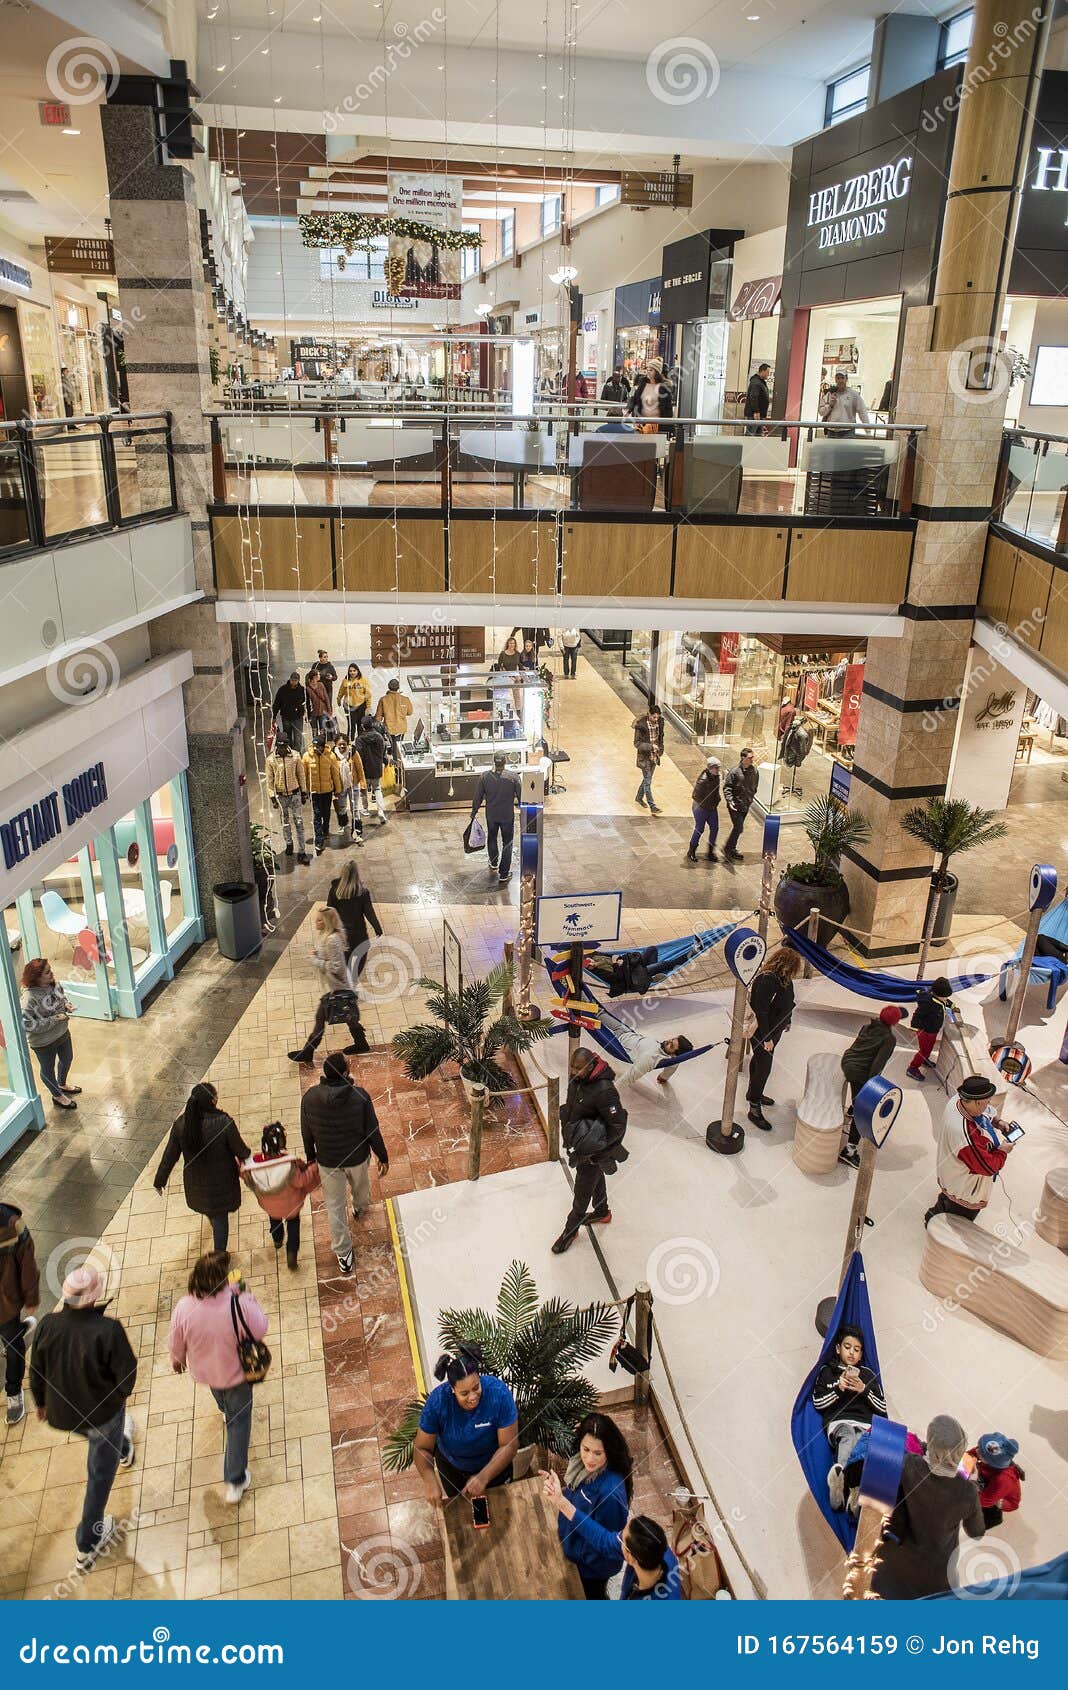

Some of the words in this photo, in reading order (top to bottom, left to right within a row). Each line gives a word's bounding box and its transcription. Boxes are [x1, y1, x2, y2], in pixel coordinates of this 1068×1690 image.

[400, 187, 410, 195] One
[412, 189, 432, 197] million
[807, 157, 912, 226] HELZBERG
[393, 196, 404, 205] One
[406, 198, 425, 206] million
[819, 209, 887, 249] DIAMONDS
[301, 346, 328, 357] DICK'S
[430, 635, 455, 647] COURT
[848, 695, 861, 710] S
[0, 791, 61, 869] DEFIANT
[62, 762, 107, 826] DOUGH
[562, 924, 593, 932] Hammock
